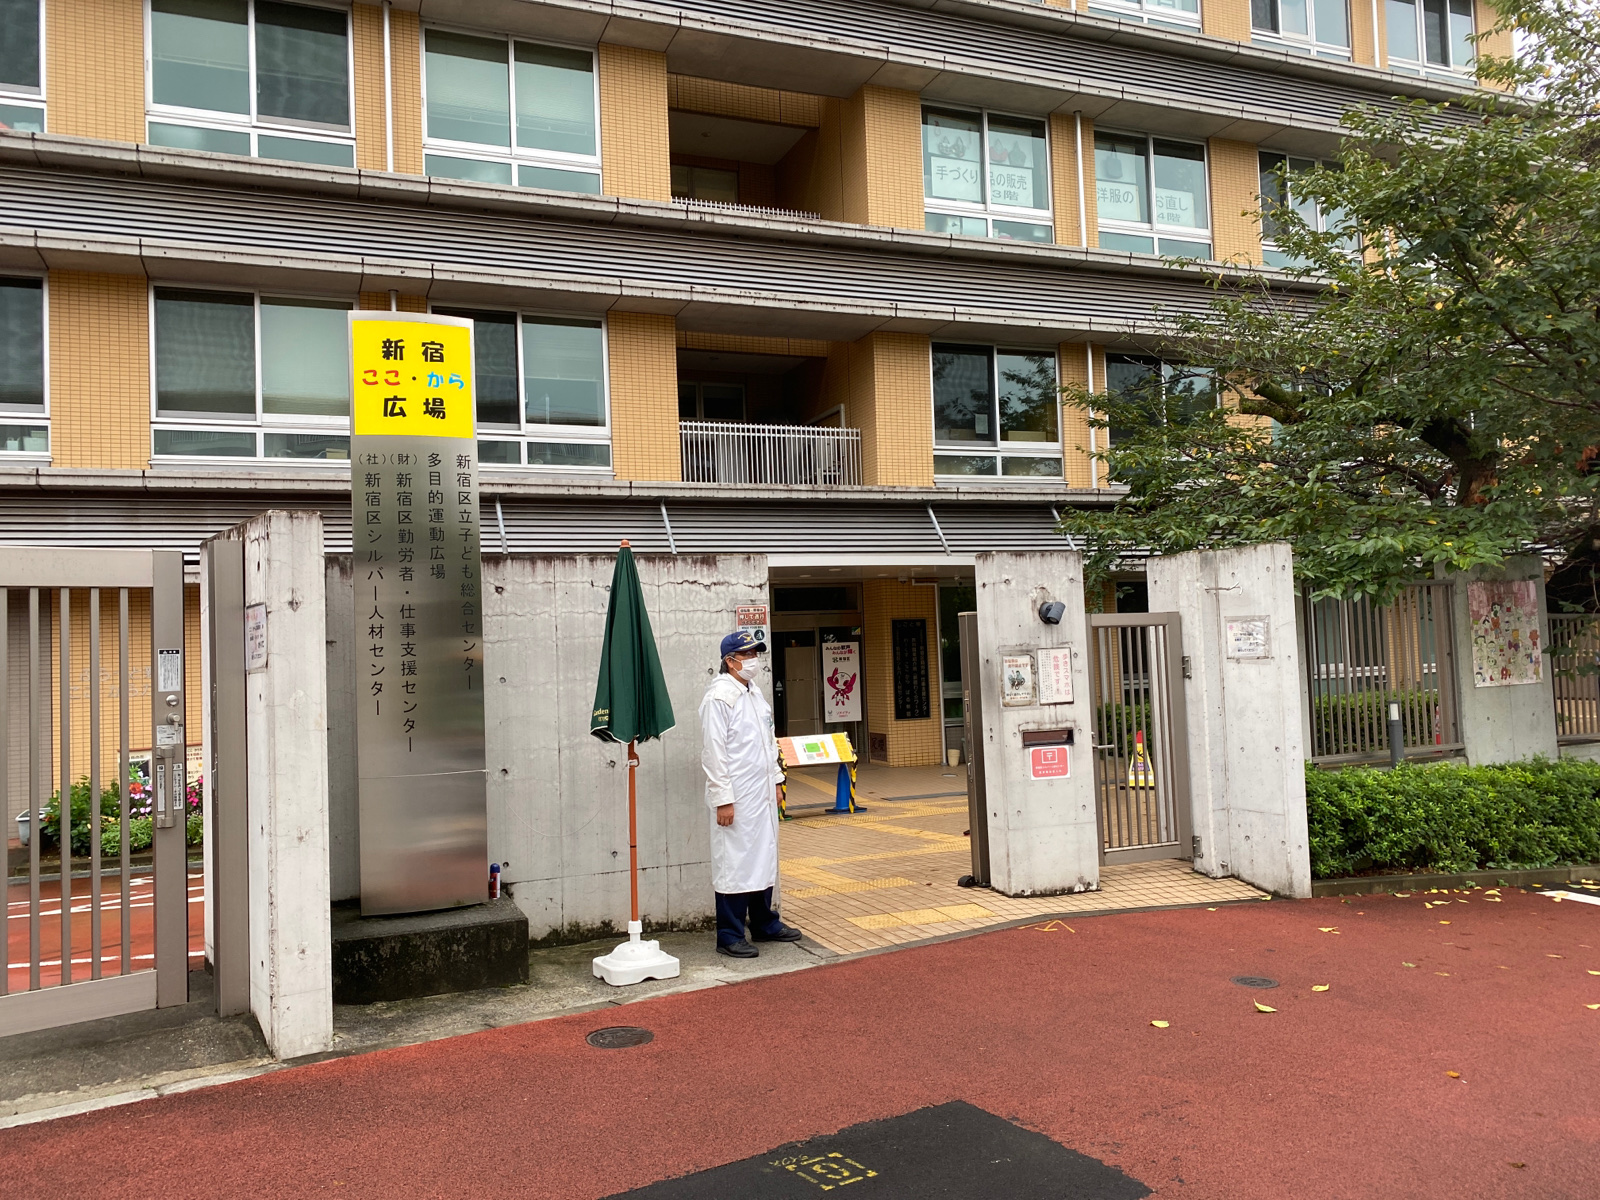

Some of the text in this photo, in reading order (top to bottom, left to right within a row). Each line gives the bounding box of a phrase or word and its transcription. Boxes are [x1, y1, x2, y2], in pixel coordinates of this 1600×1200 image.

[935, 166, 979, 184] 手づくり
[1097, 187, 1134, 204] 洋服の
[381, 338, 445, 363] 新宿
[362, 369, 465, 390] ここ・から
[383, 395, 446, 420] 広場
[428, 452, 445, 579] 多目的運動広場
[456, 454, 476, 690] 新宿区立子ども総合センター
[1062, 653, 1070, 695] 歩きスマホは
